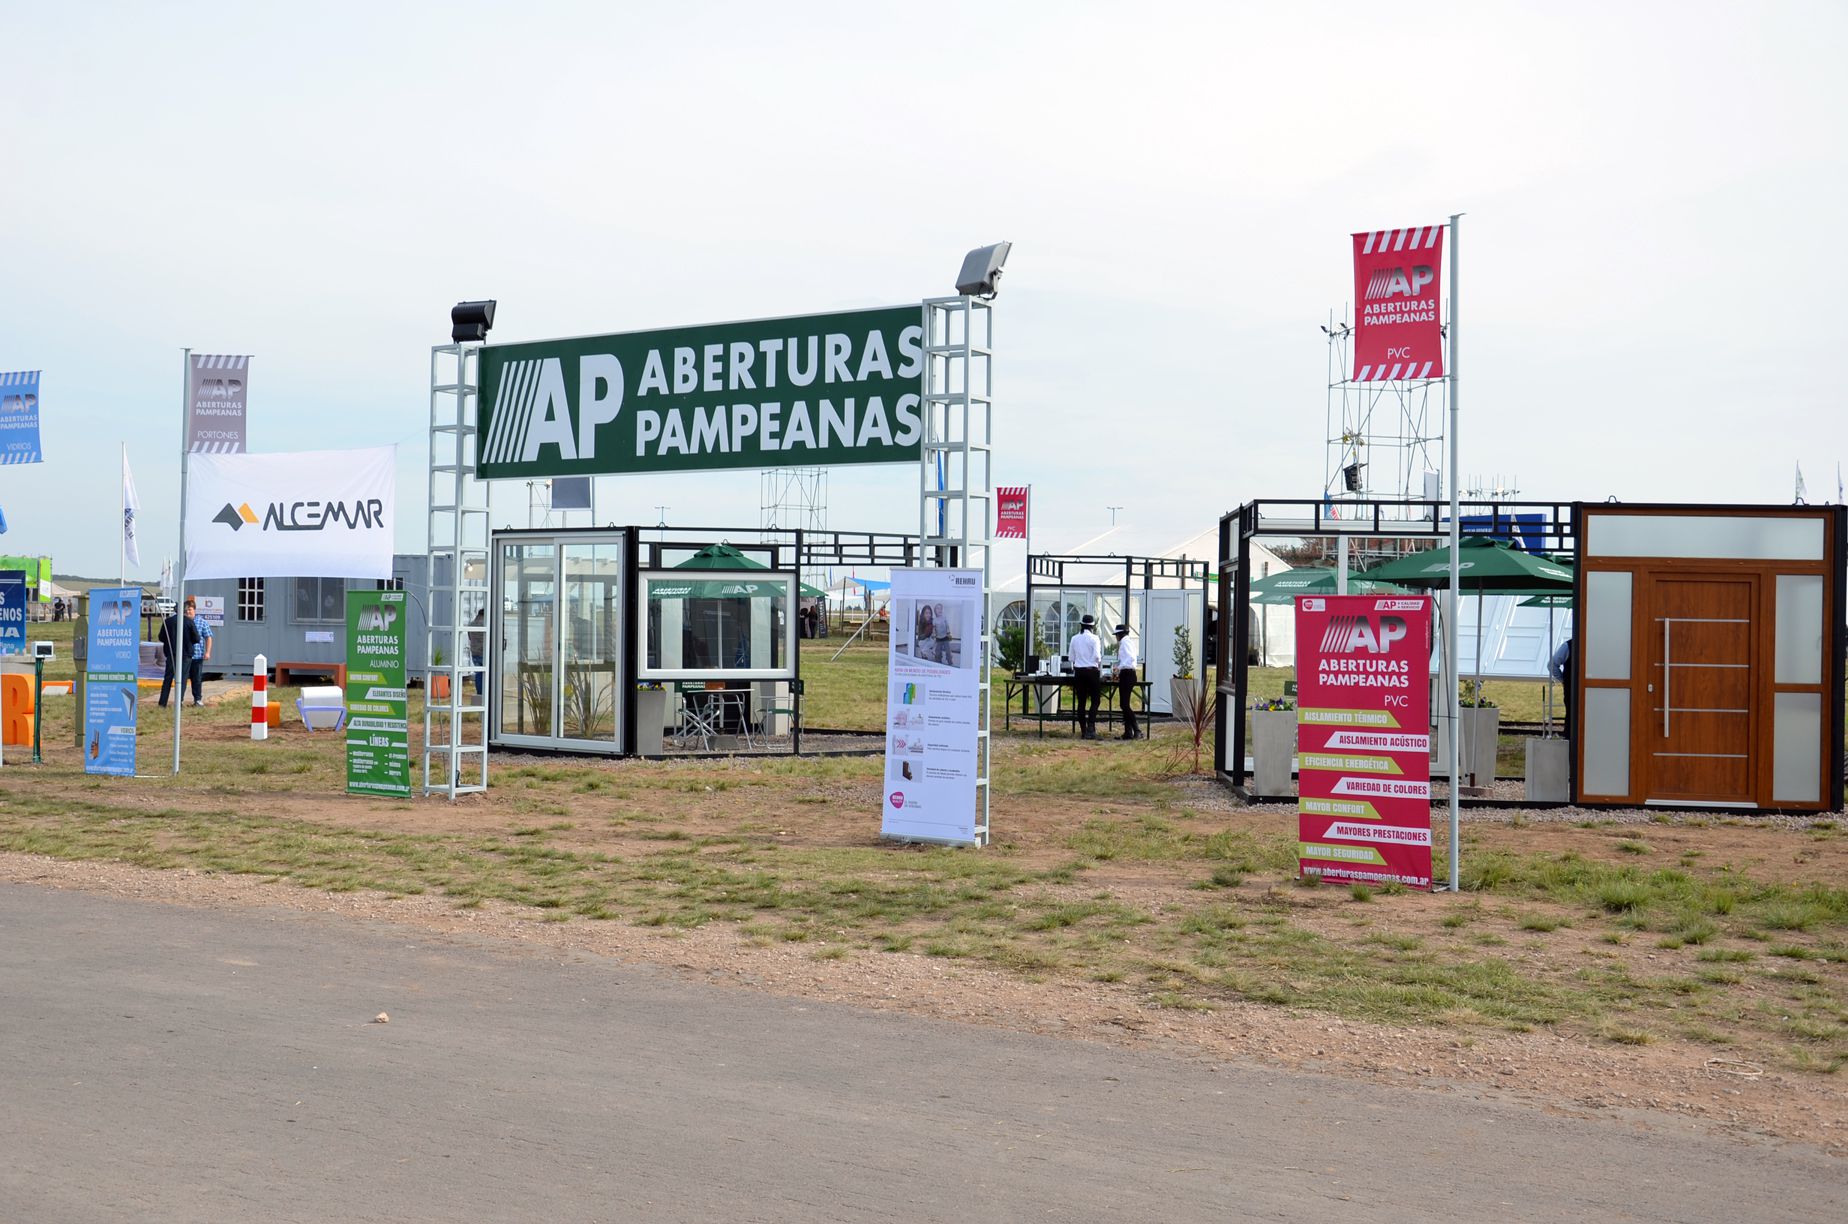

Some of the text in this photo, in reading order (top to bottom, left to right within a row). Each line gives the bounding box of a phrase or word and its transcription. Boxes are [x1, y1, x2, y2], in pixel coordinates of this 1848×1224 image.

[1385, 265, 1434, 297] AP
[1364, 299, 1435, 315] ABERTURAS
[1364, 311, 1436, 326] PAMPEANAS
[1387, 347, 1411, 359] PVC
[637, 325, 923, 397] ABERTURAS
[212, 379, 242, 399] AP
[196, 401, 242, 409] ABERTURAS
[521, 354, 625, 463] AP
[195, 409, 242, 417] PAMPEANAS
[635, 393, 922, 457] PAMPEANAS
[197, 431, 239, 439] PORTONES
[262, 499, 384, 531] ALCEMAR
[369, 604, 397, 631] AP
[97, 629, 132, 638] ABERTURAS
[357, 635, 399, 645] ABERTURAS
[1344, 615, 1407, 653] AP
[357, 645, 399, 655] PAMPEANAS
[369, 660, 400, 669] ALUMINIO
[1319, 659, 1408, 673] ABERTURAS
[1319, 674, 1409, 687] PAMPEANAS
[1384, 695, 1408, 707] PVC
[1304, 711, 1387, 724] AISLAMIENTO TÉRMICO
[1339, 735, 1427, 748] AISLAMIENTO ACÚSTICO
[1305, 756, 1389, 770] EFICIENCIA ENERGÉTICA
[1346, 782, 1427, 795] VARIEDAD DE COLORES
[1305, 801, 1365, 814] MAYOR CONFORT
[1336, 826, 1427, 842] MAYORES PRESTACIONES
[1306, 846, 1374, 860] MAYOR SEGURIDAD
